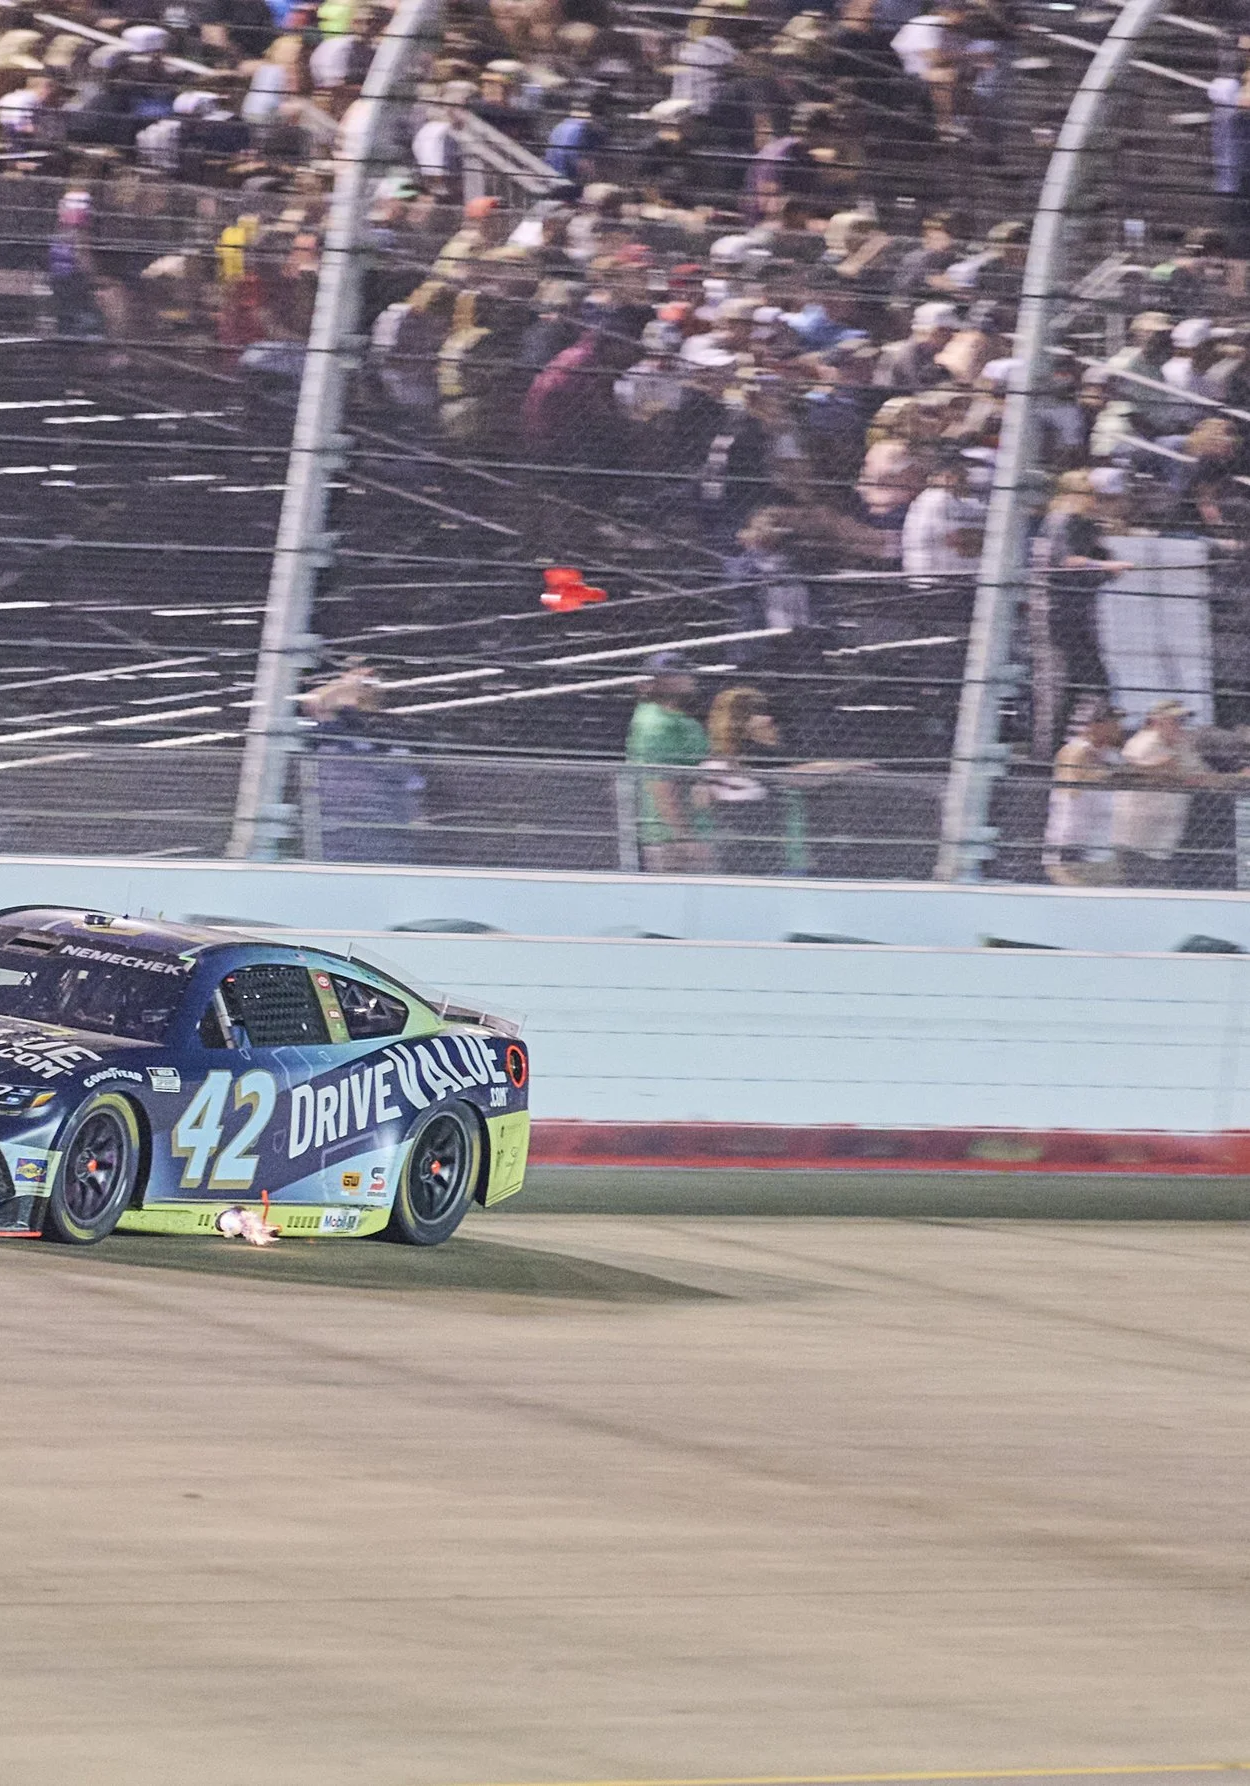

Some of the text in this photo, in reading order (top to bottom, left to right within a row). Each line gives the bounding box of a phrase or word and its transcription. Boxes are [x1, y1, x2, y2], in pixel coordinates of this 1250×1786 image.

[60, 944, 183, 976] NEMECHEK
[83, 1066, 143, 1088] GOODYEAR
[171, 1068, 277, 1190] 42
